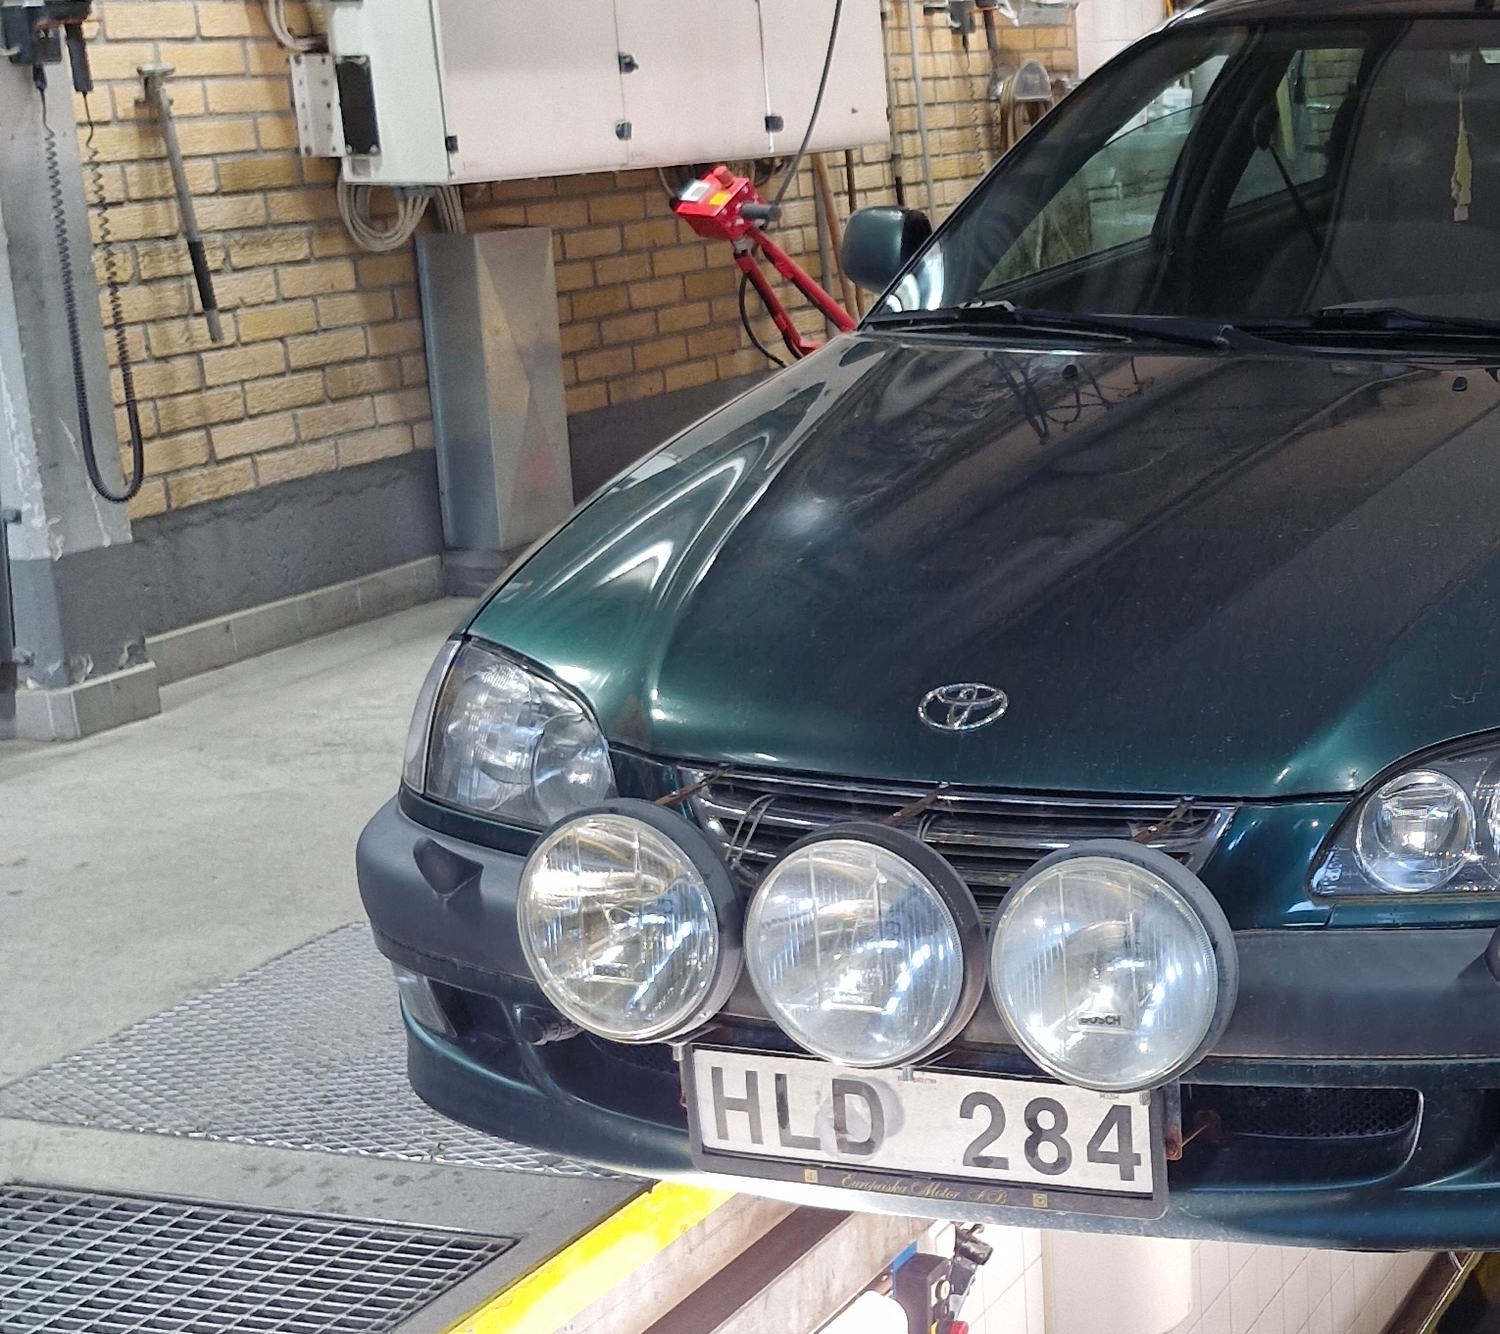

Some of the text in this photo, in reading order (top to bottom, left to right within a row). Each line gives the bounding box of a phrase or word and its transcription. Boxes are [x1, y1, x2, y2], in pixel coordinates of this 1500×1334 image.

[1079, 1013, 1122, 1026] BOSCH
[711, 1066, 1142, 1182] HLD 284
[910, 1181, 960, 1200] Motor
